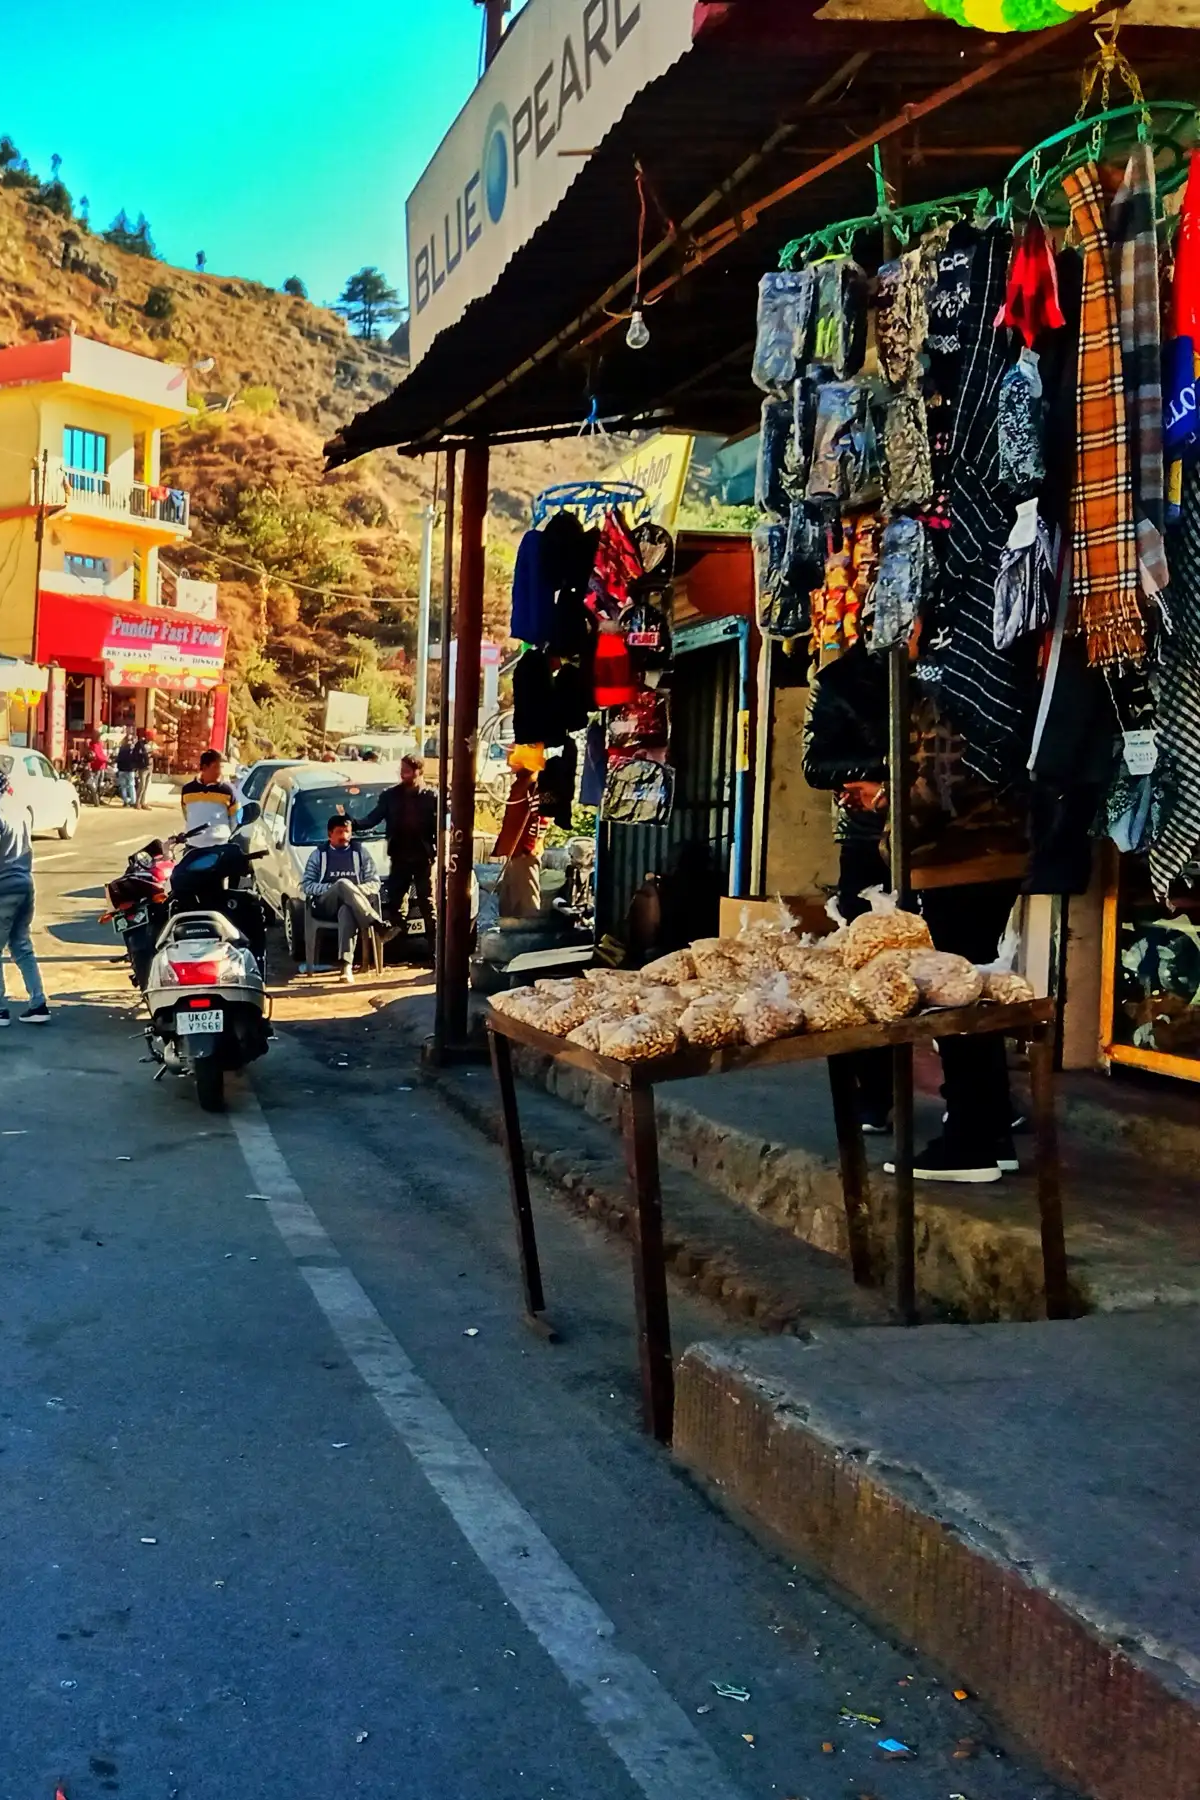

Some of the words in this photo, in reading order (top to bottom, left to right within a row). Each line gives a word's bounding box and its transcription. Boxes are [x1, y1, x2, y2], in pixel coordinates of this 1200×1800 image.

[415, 170, 482, 316] BLUE
[511, 0, 641, 189] PEARL
[112, 616, 159, 640] Pundir
[160, 620, 189, 642] Fast
[190, 625, 223, 647] Food
